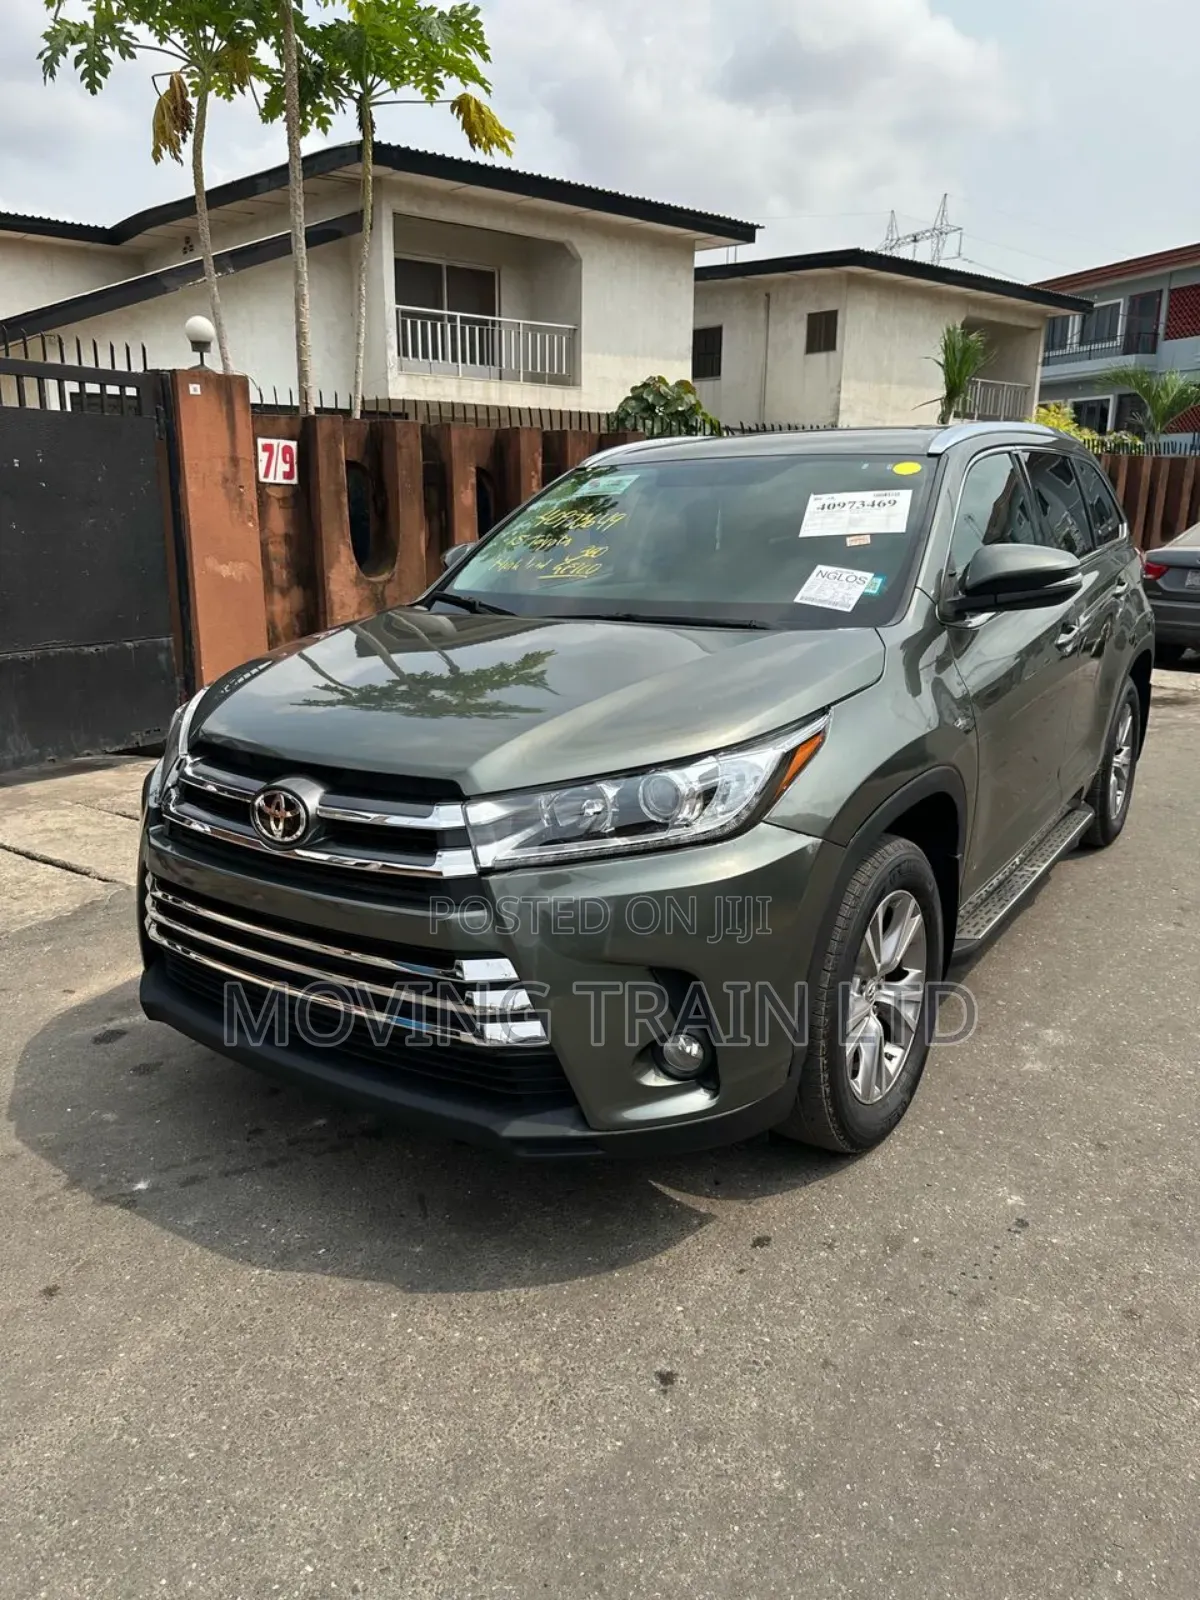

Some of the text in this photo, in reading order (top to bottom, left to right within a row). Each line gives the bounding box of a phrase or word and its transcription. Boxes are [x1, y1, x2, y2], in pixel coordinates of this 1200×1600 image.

[261, 442, 295, 480] 7/9
[816, 499, 897, 511] 40973469
[816, 569, 868, 585] NGLOS
